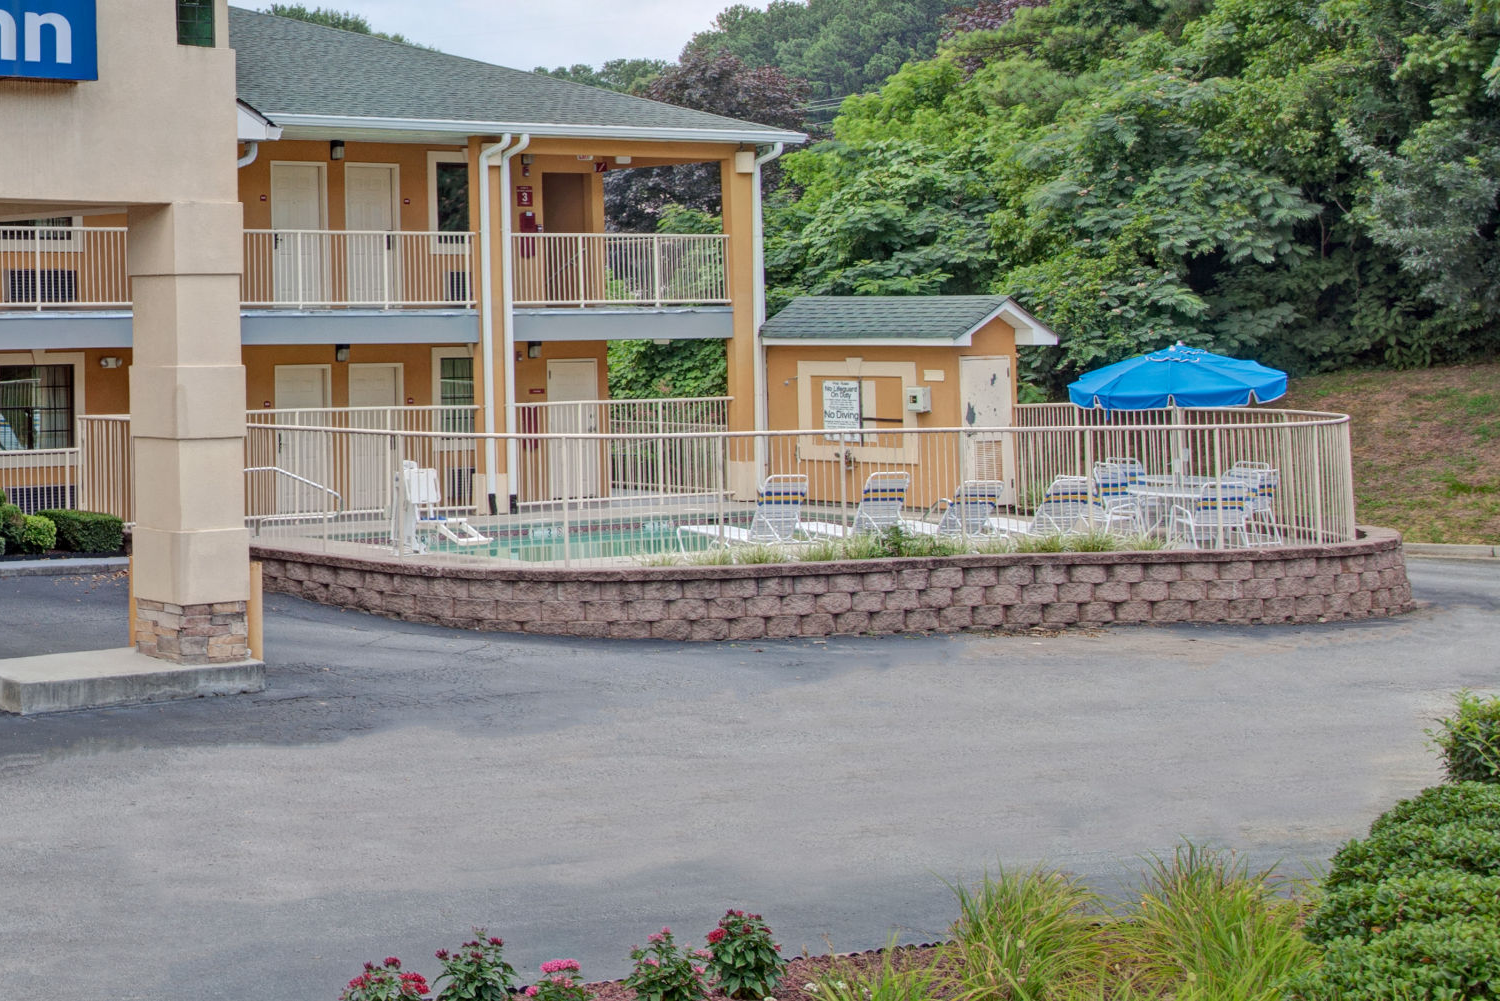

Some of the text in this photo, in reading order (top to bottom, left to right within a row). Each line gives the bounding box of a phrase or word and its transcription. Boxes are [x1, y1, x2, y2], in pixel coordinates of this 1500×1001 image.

[522, 192, 528, 201] 3
[824, 410, 859, 421] No Diving
